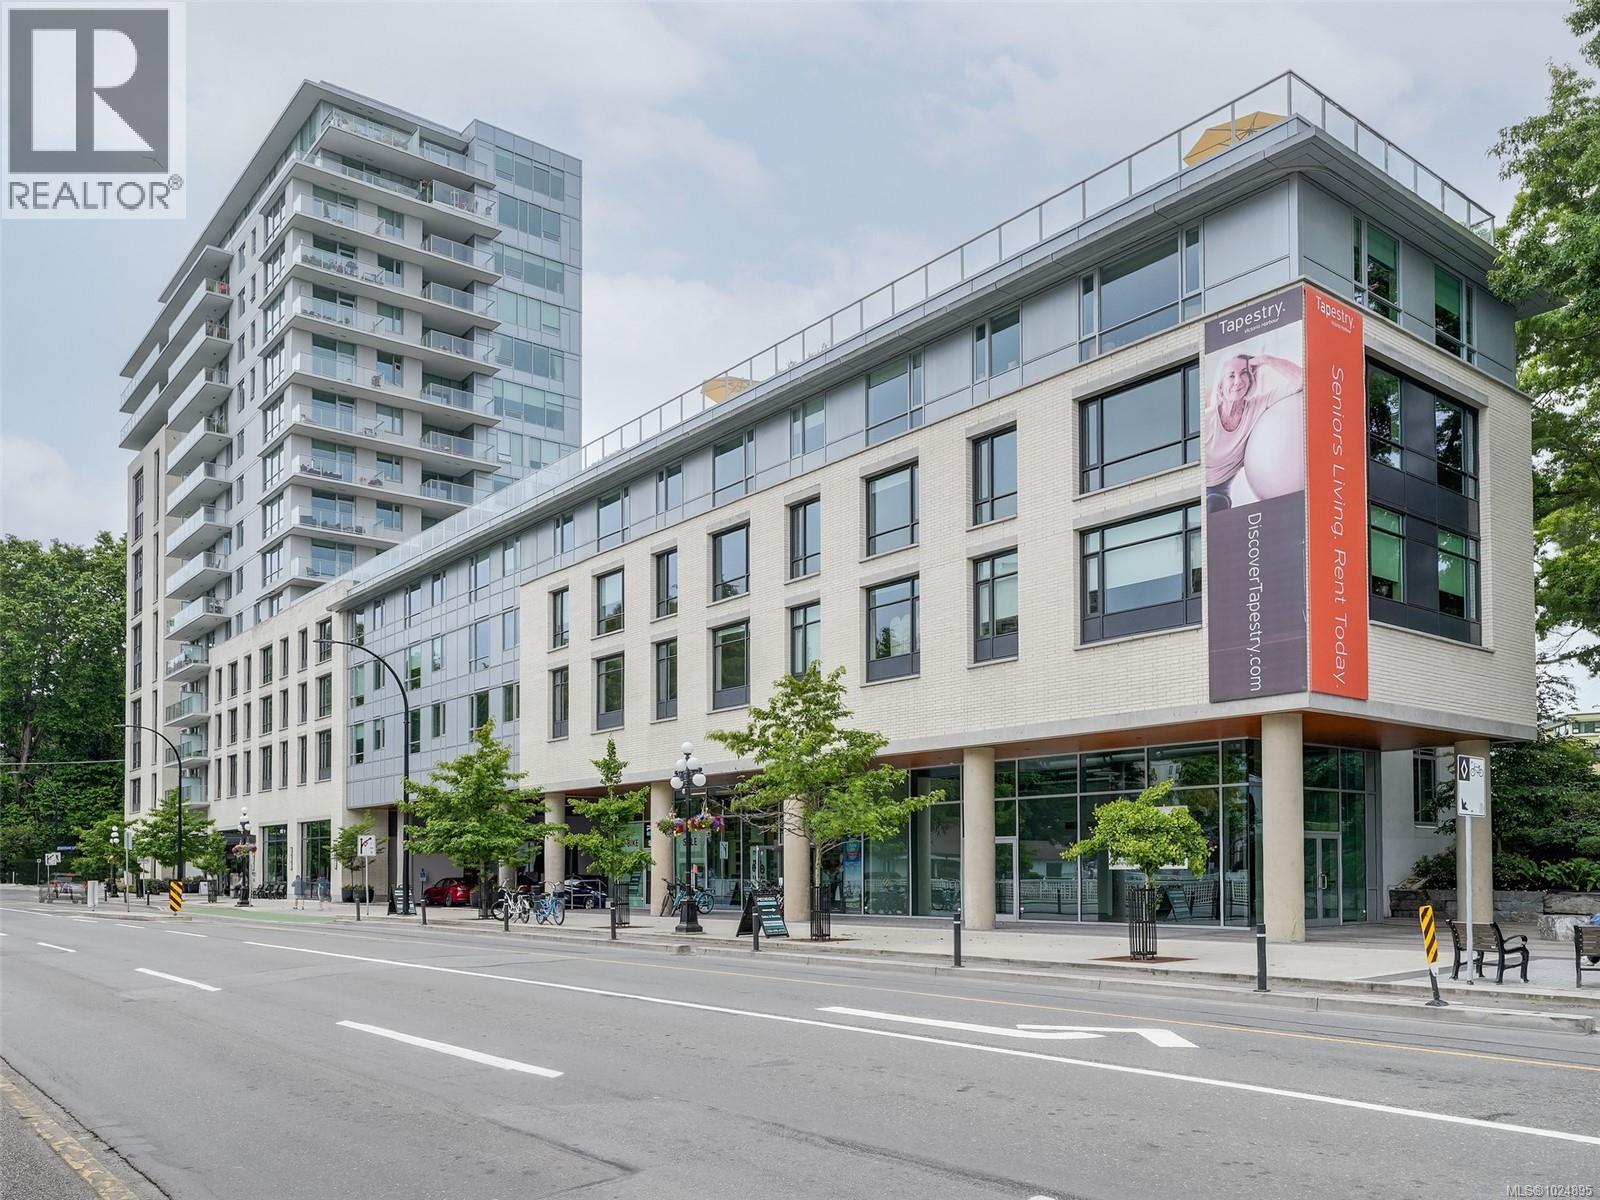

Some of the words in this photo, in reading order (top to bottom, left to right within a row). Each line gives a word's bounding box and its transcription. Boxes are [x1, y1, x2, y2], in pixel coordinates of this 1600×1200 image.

[1219, 301, 1286, 334] Tapestry.
[1315, 295, 1355, 330] Tapestry.
[1332, 364, 1344, 456] Seniors
[1331, 464, 1346, 539] Living.
[1246, 512, 1263, 692] DiscoverTapestry.com
[1334, 548, 1347, 603] Rent
[1333, 613, 1347, 688] Today.
[682, 837, 698, 847] SLE
